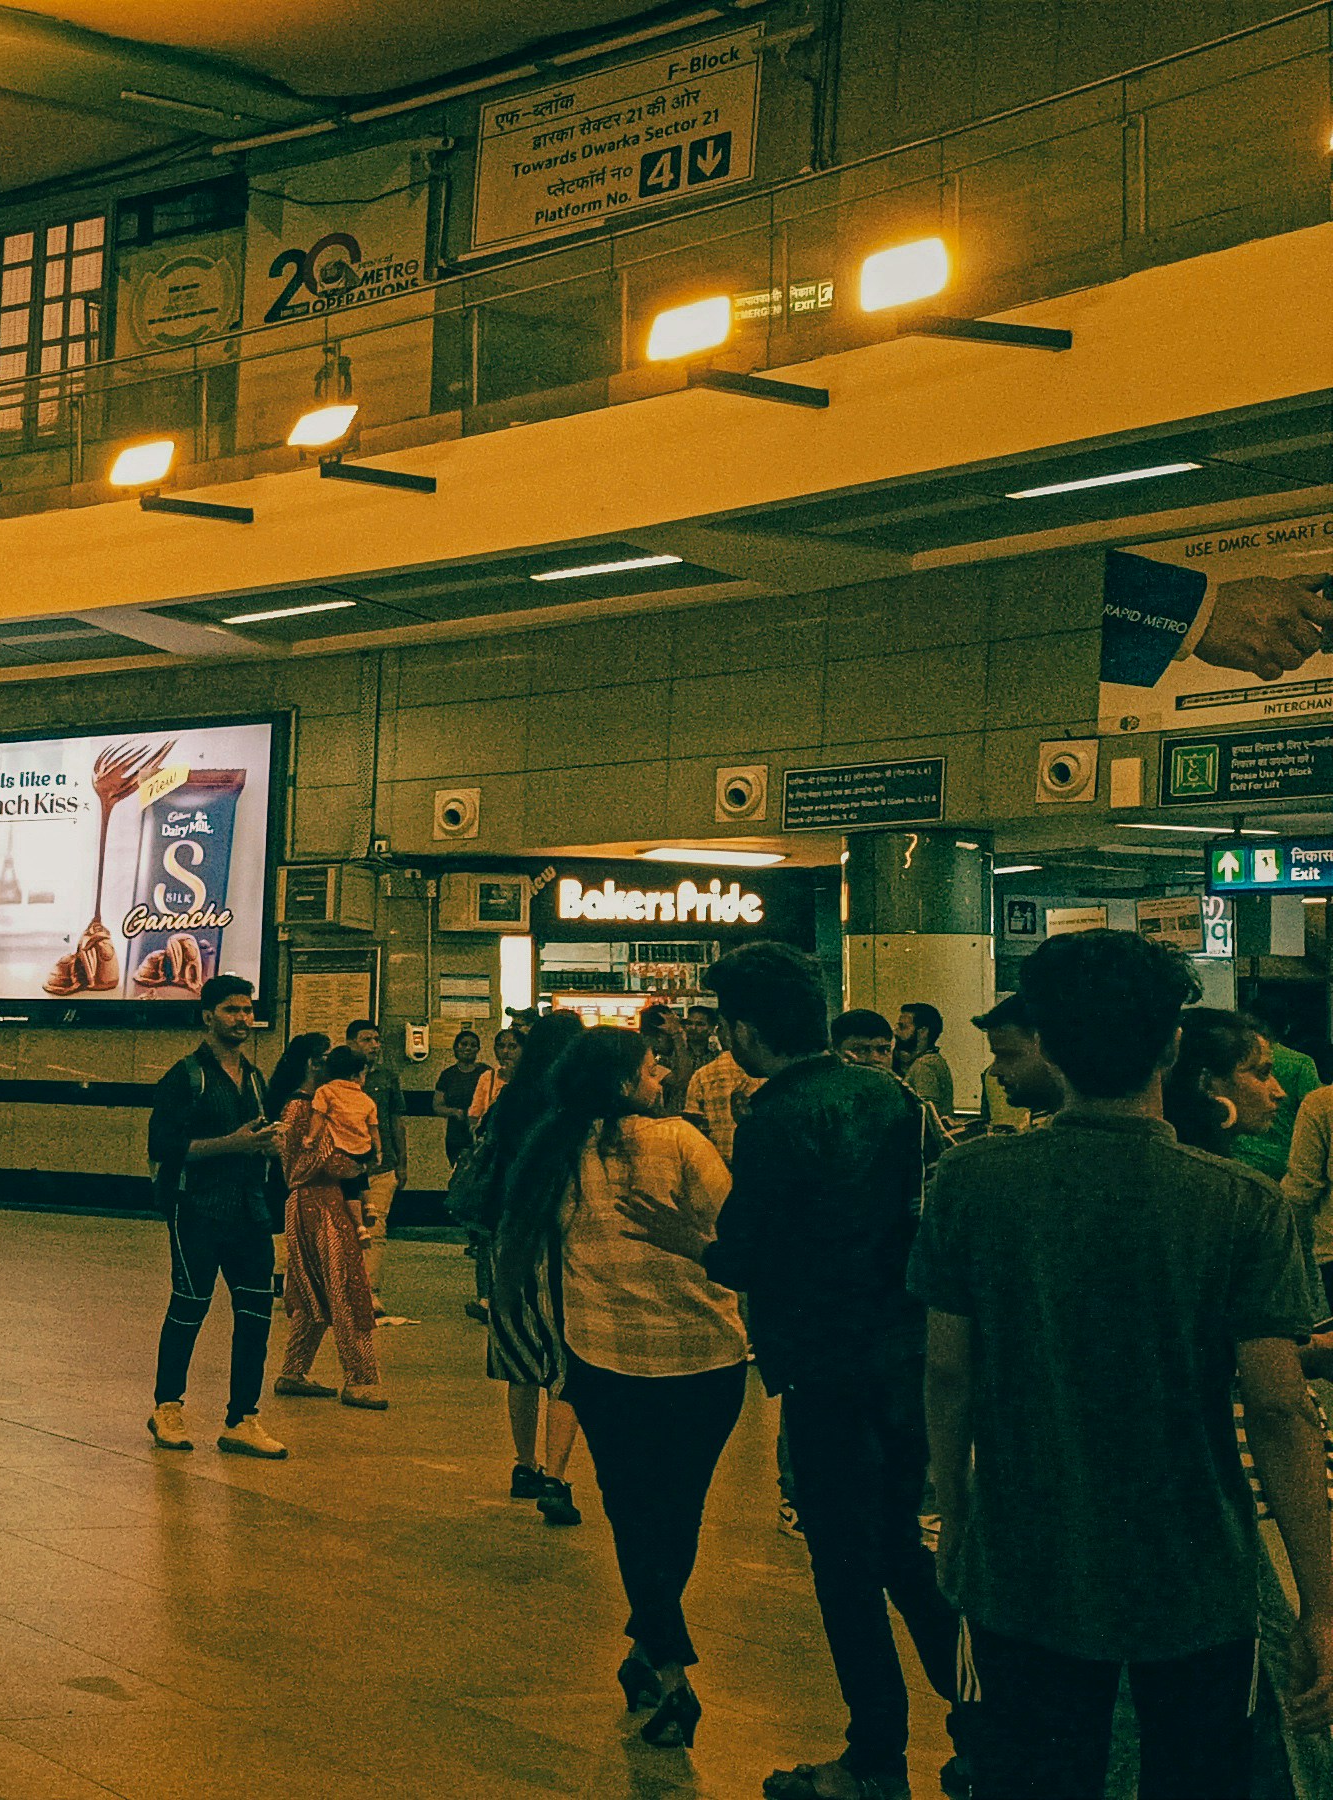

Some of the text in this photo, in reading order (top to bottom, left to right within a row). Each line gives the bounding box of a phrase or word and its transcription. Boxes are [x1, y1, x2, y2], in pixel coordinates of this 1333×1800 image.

[667, 46, 741, 81] F-Block
[532, 87, 702, 150] द्वारका सेक्टर 21 की ओर
[512, 108, 721, 179] Towards Dwarka Sector 21
[646, 151, 675, 189] 4
[533, 190, 633, 226] Platform No.
[359, 259, 419, 287] METRO
[312, 277, 420, 313] OPERATIONS
[794, 299, 816, 312] EXIT
[1184, 541, 1214, 558] USE
[1217, 533, 1262, 554] DMRC
[1265, 524, 1317, 546] SMART
[1101, 603, 1189, 635] RAPID METRO
[19, 771, 51, 788] like
[55, 773, 67, 786] a
[148, 773, 177, 798] New
[1230, 766, 1313, 781] Please Use A-Block
[1248, 781, 1263, 791] For
[1264, 780, 1280, 789] Lift
[34, 792, 78, 815] Kiss
[161, 823, 190, 838] Dairy
[153, 839, 207, 914] S
[1290, 866, 1321, 881] Exit
[165, 891, 192, 904] SILK
[122, 902, 234, 939] Ganache
